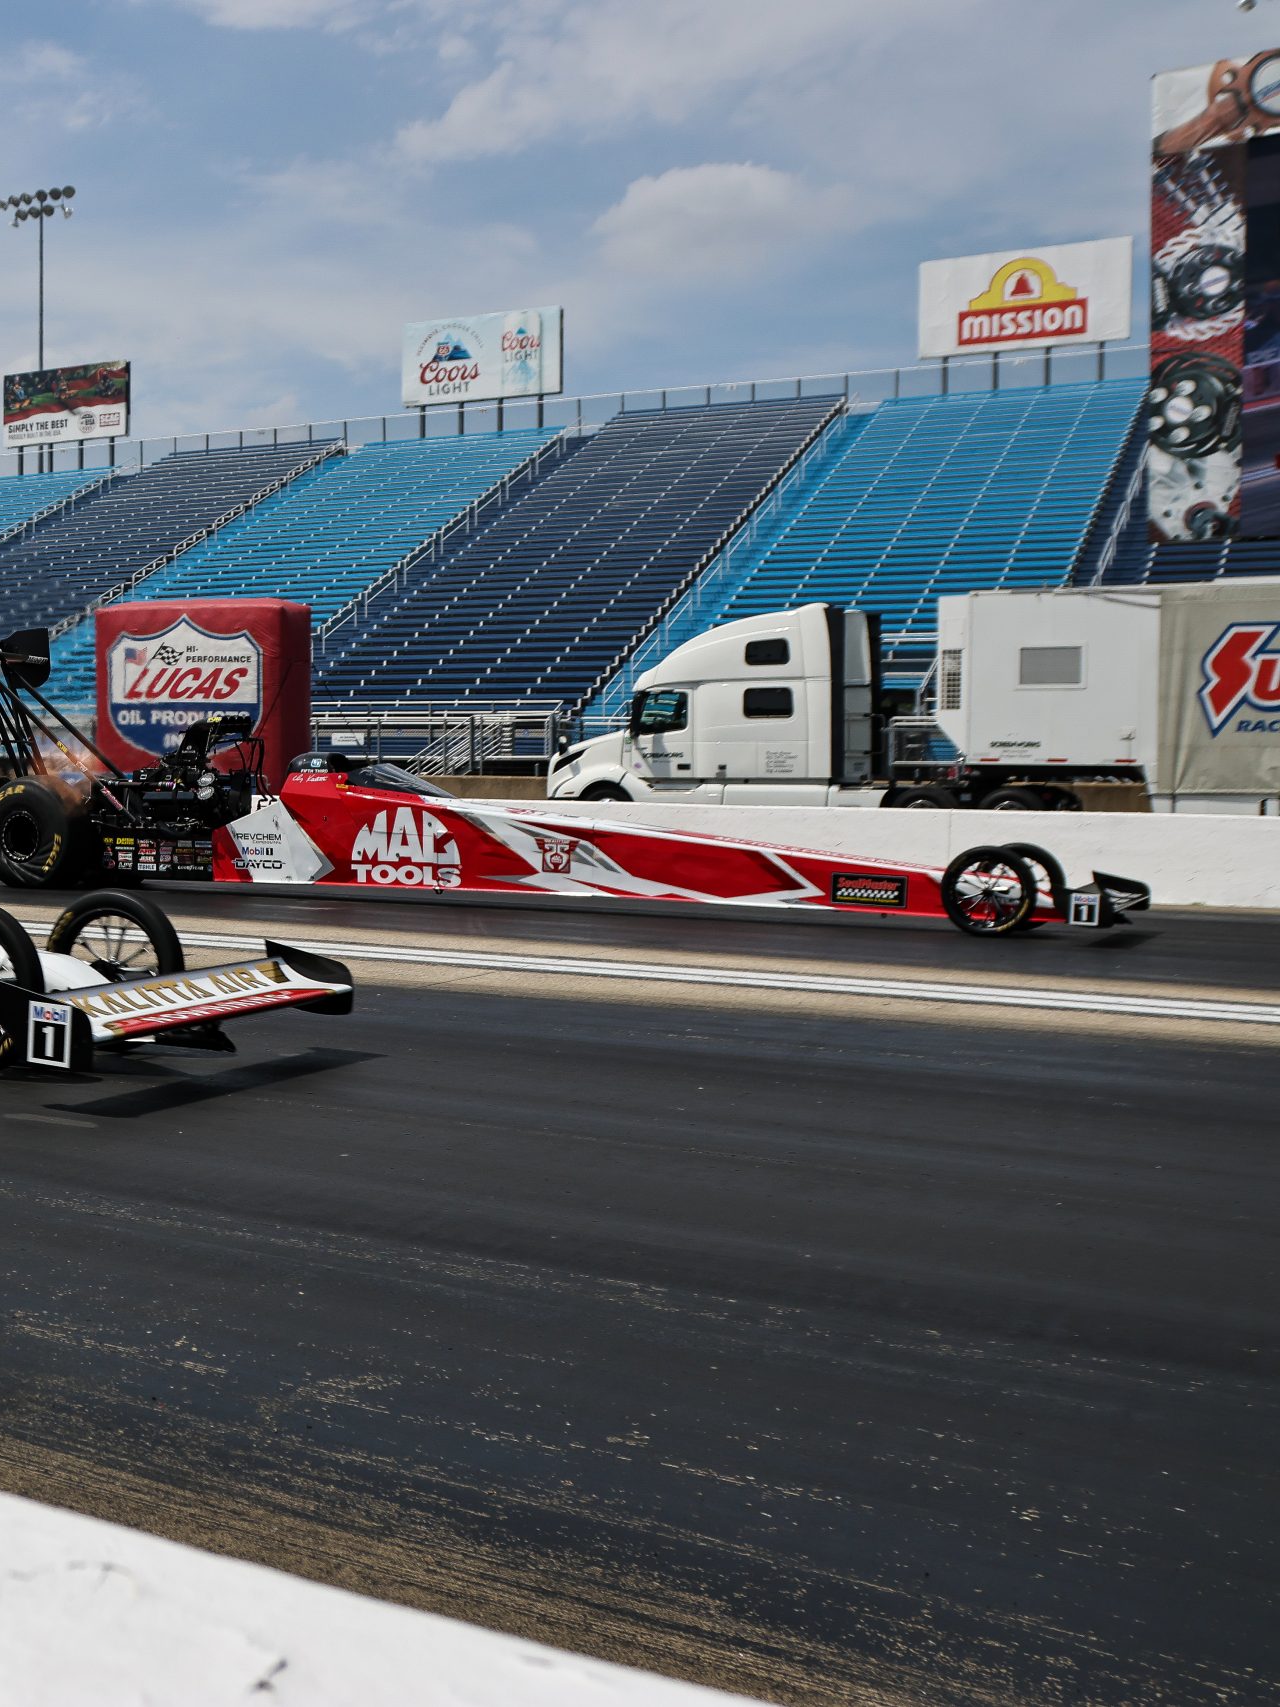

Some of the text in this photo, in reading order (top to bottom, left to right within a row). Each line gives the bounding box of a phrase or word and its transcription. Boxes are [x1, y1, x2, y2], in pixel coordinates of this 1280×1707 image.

[420, 361, 480, 385] Coors
[429, 382, 470, 396] LIGHT
[124, 667, 249, 700] LUCAS
[117, 710, 146, 726] OIL
[351, 807, 462, 864] MAC
[241, 847, 264, 855] Mobil
[234, 859, 284, 870] DAYCO
[352, 864, 462, 888] TOOLS
[1074, 894, 1098, 904] Mobil
[70, 967, 268, 1018] KALITTA AIR
[32, 1005, 68, 1023] Mobil
